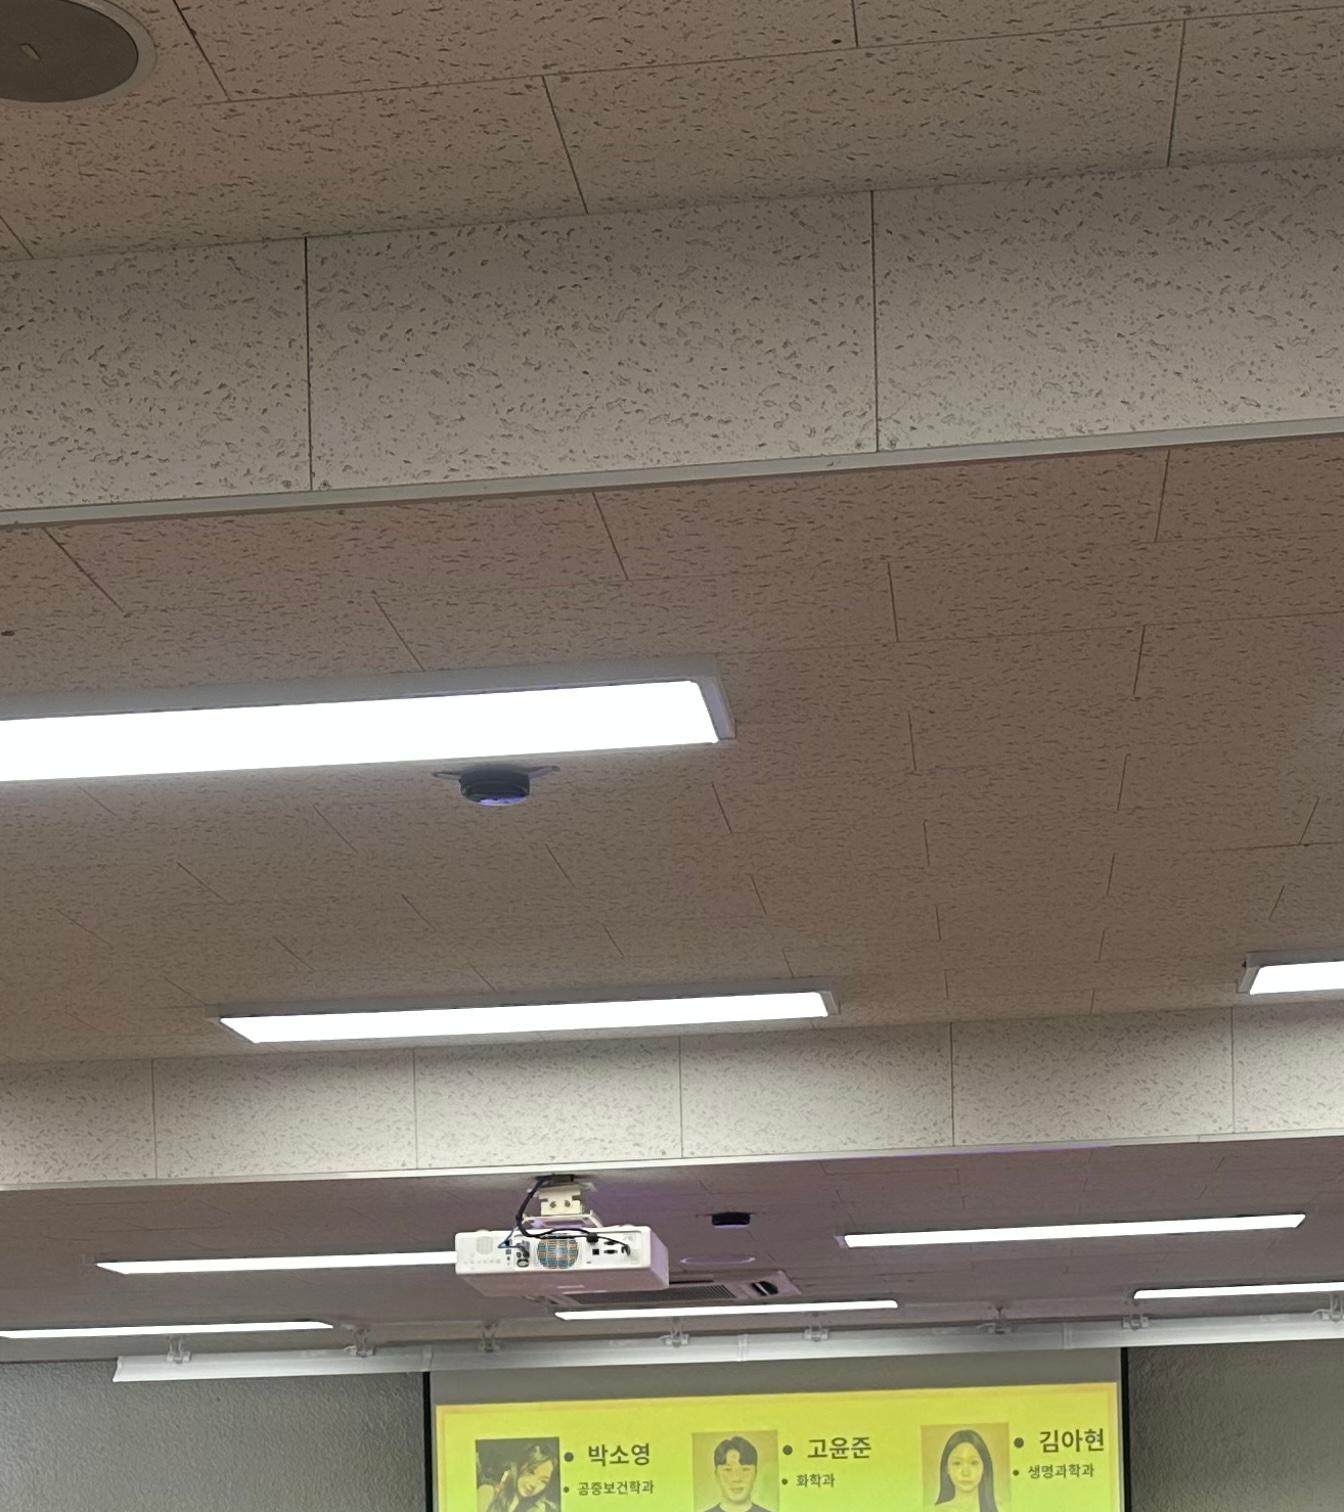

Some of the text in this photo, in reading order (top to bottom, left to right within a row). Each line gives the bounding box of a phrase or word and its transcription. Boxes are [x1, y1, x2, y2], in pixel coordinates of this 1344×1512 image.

[807, 1436, 872, 1459] 고윤준
[1039, 1428, 1104, 1453] 김아현
[588, 1443, 651, 1466] 박소영
[796, 1473, 835, 1488] 화학과
[1028, 1464, 1095, 1479] 생명과학과
[577, 1480, 654, 1496] 공중보건학과
